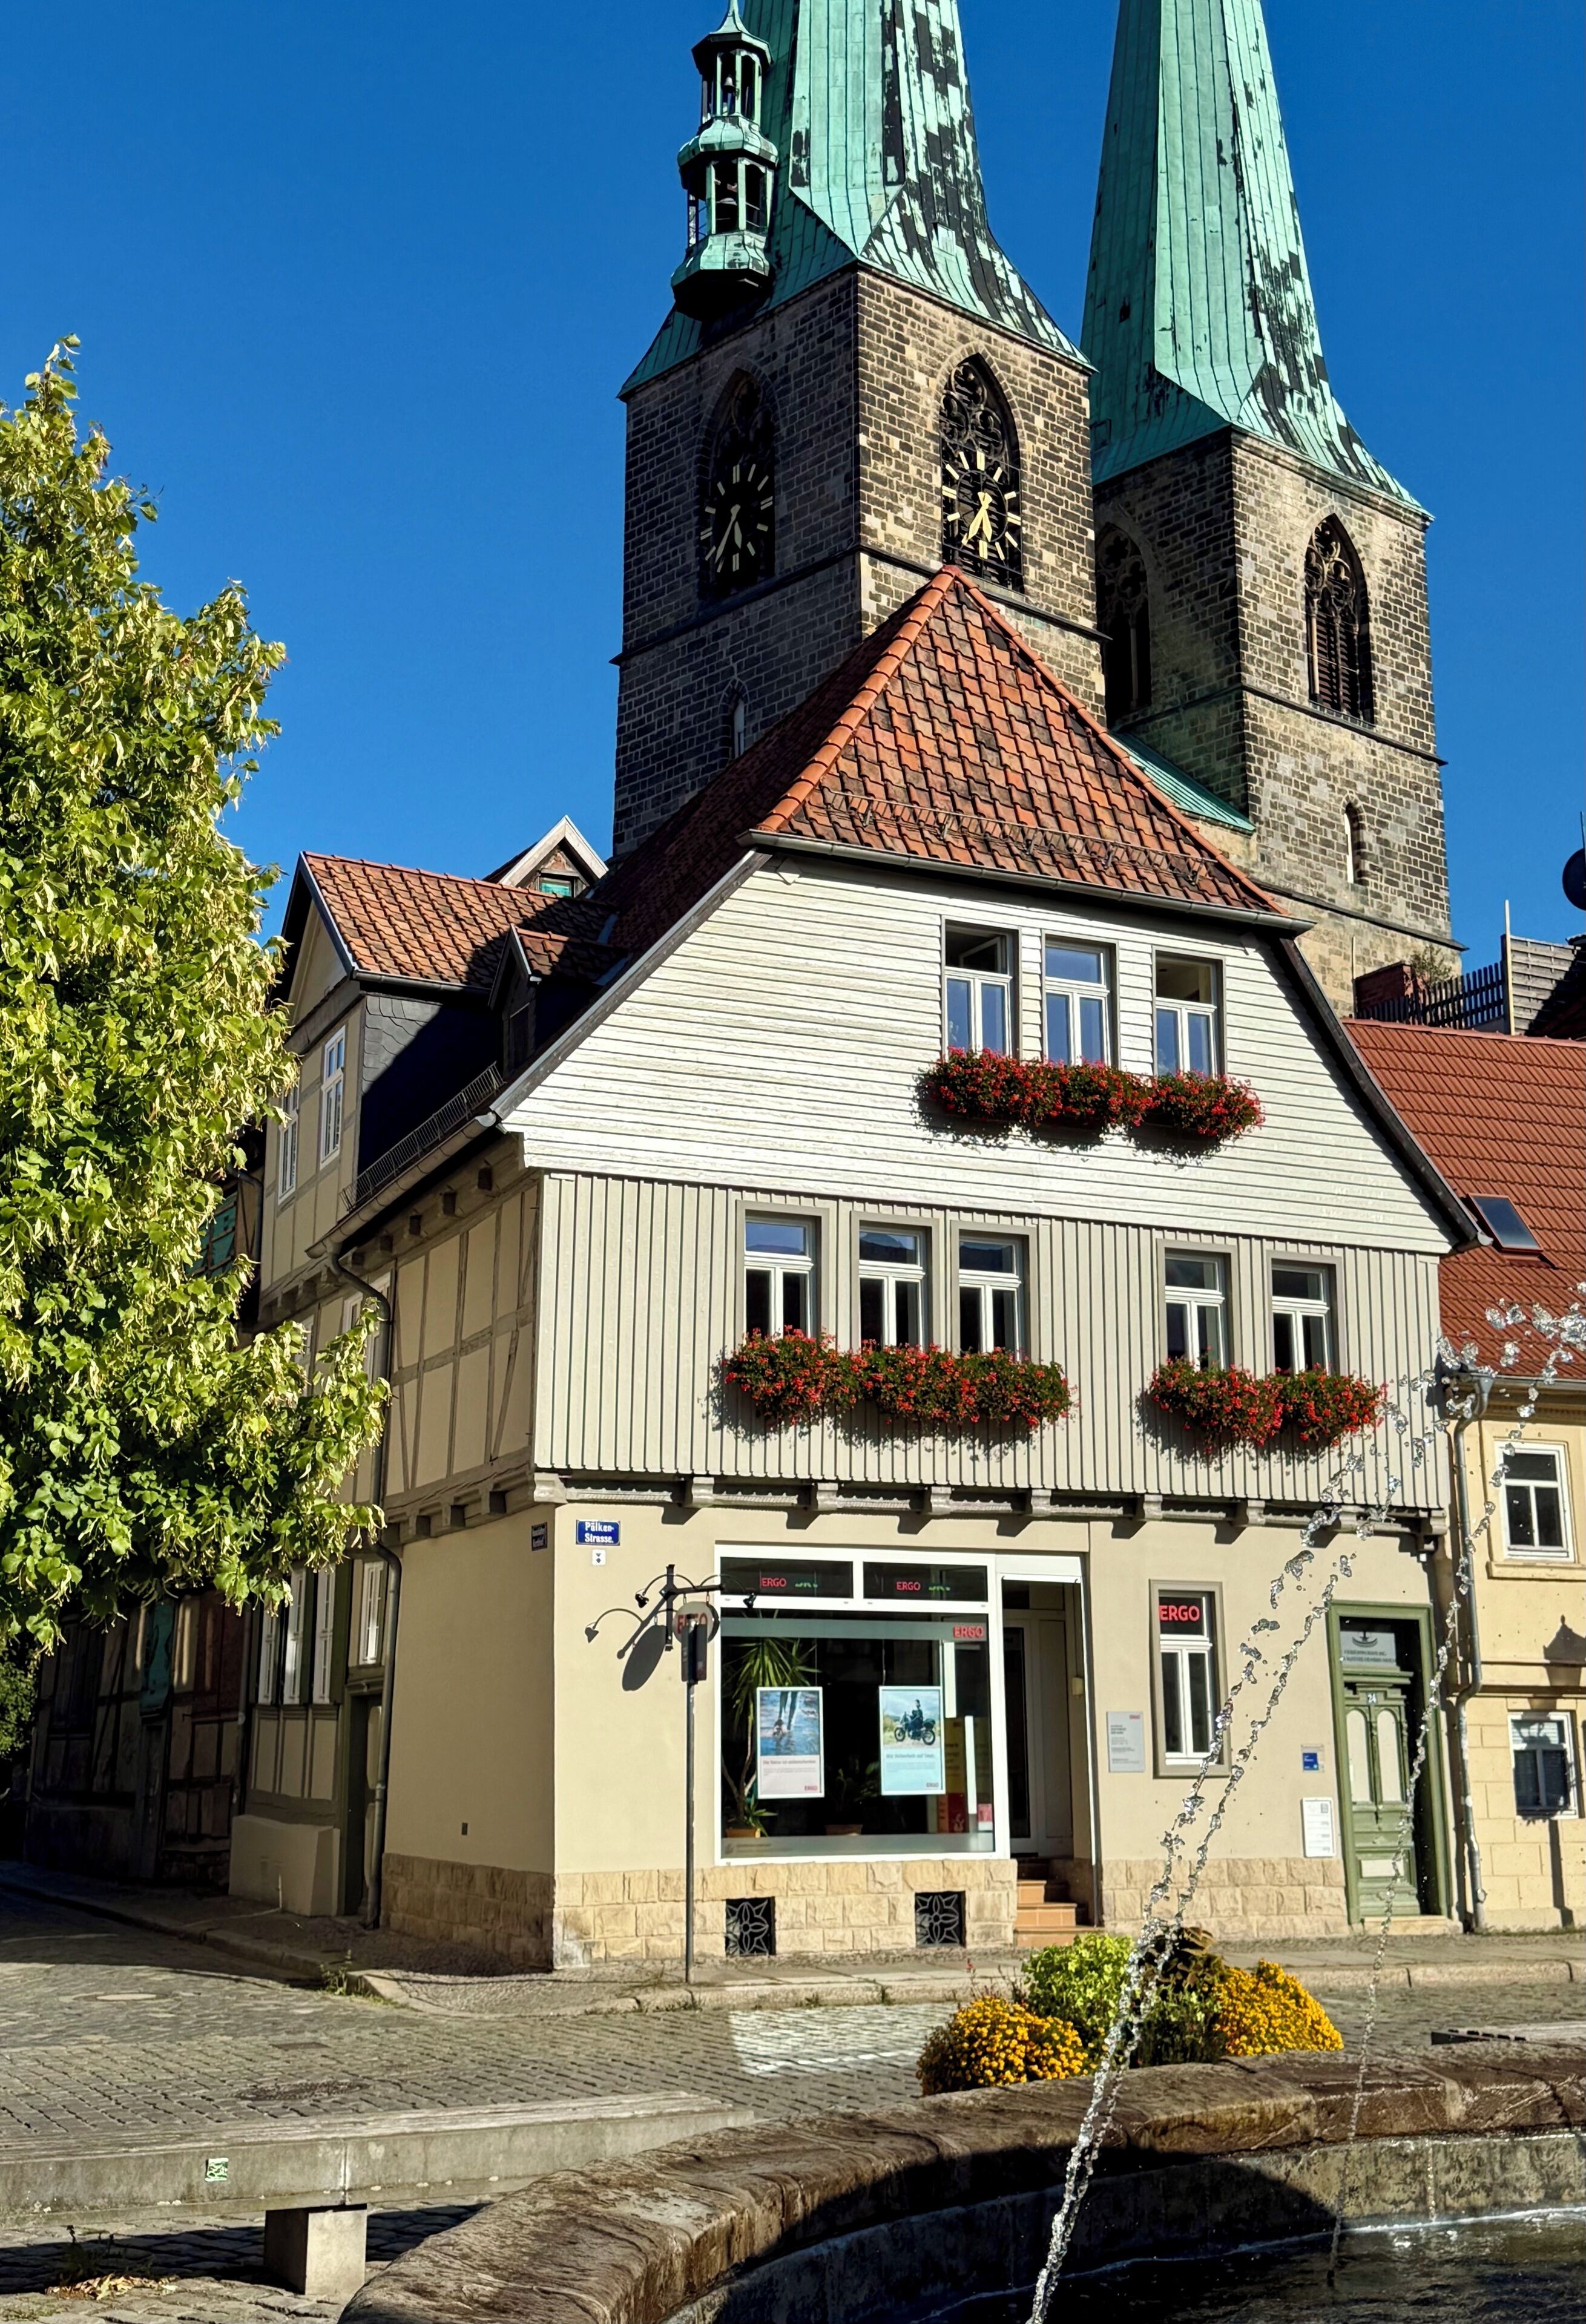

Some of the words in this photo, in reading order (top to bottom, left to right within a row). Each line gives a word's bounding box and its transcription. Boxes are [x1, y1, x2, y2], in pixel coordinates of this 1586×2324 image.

[761, 1578, 786, 1587] ERGO
[897, 1581, 921, 1591] ERGO
[1159, 1605, 1200, 1621] ERGO
[953, 1626, 984, 1638] ERGO
